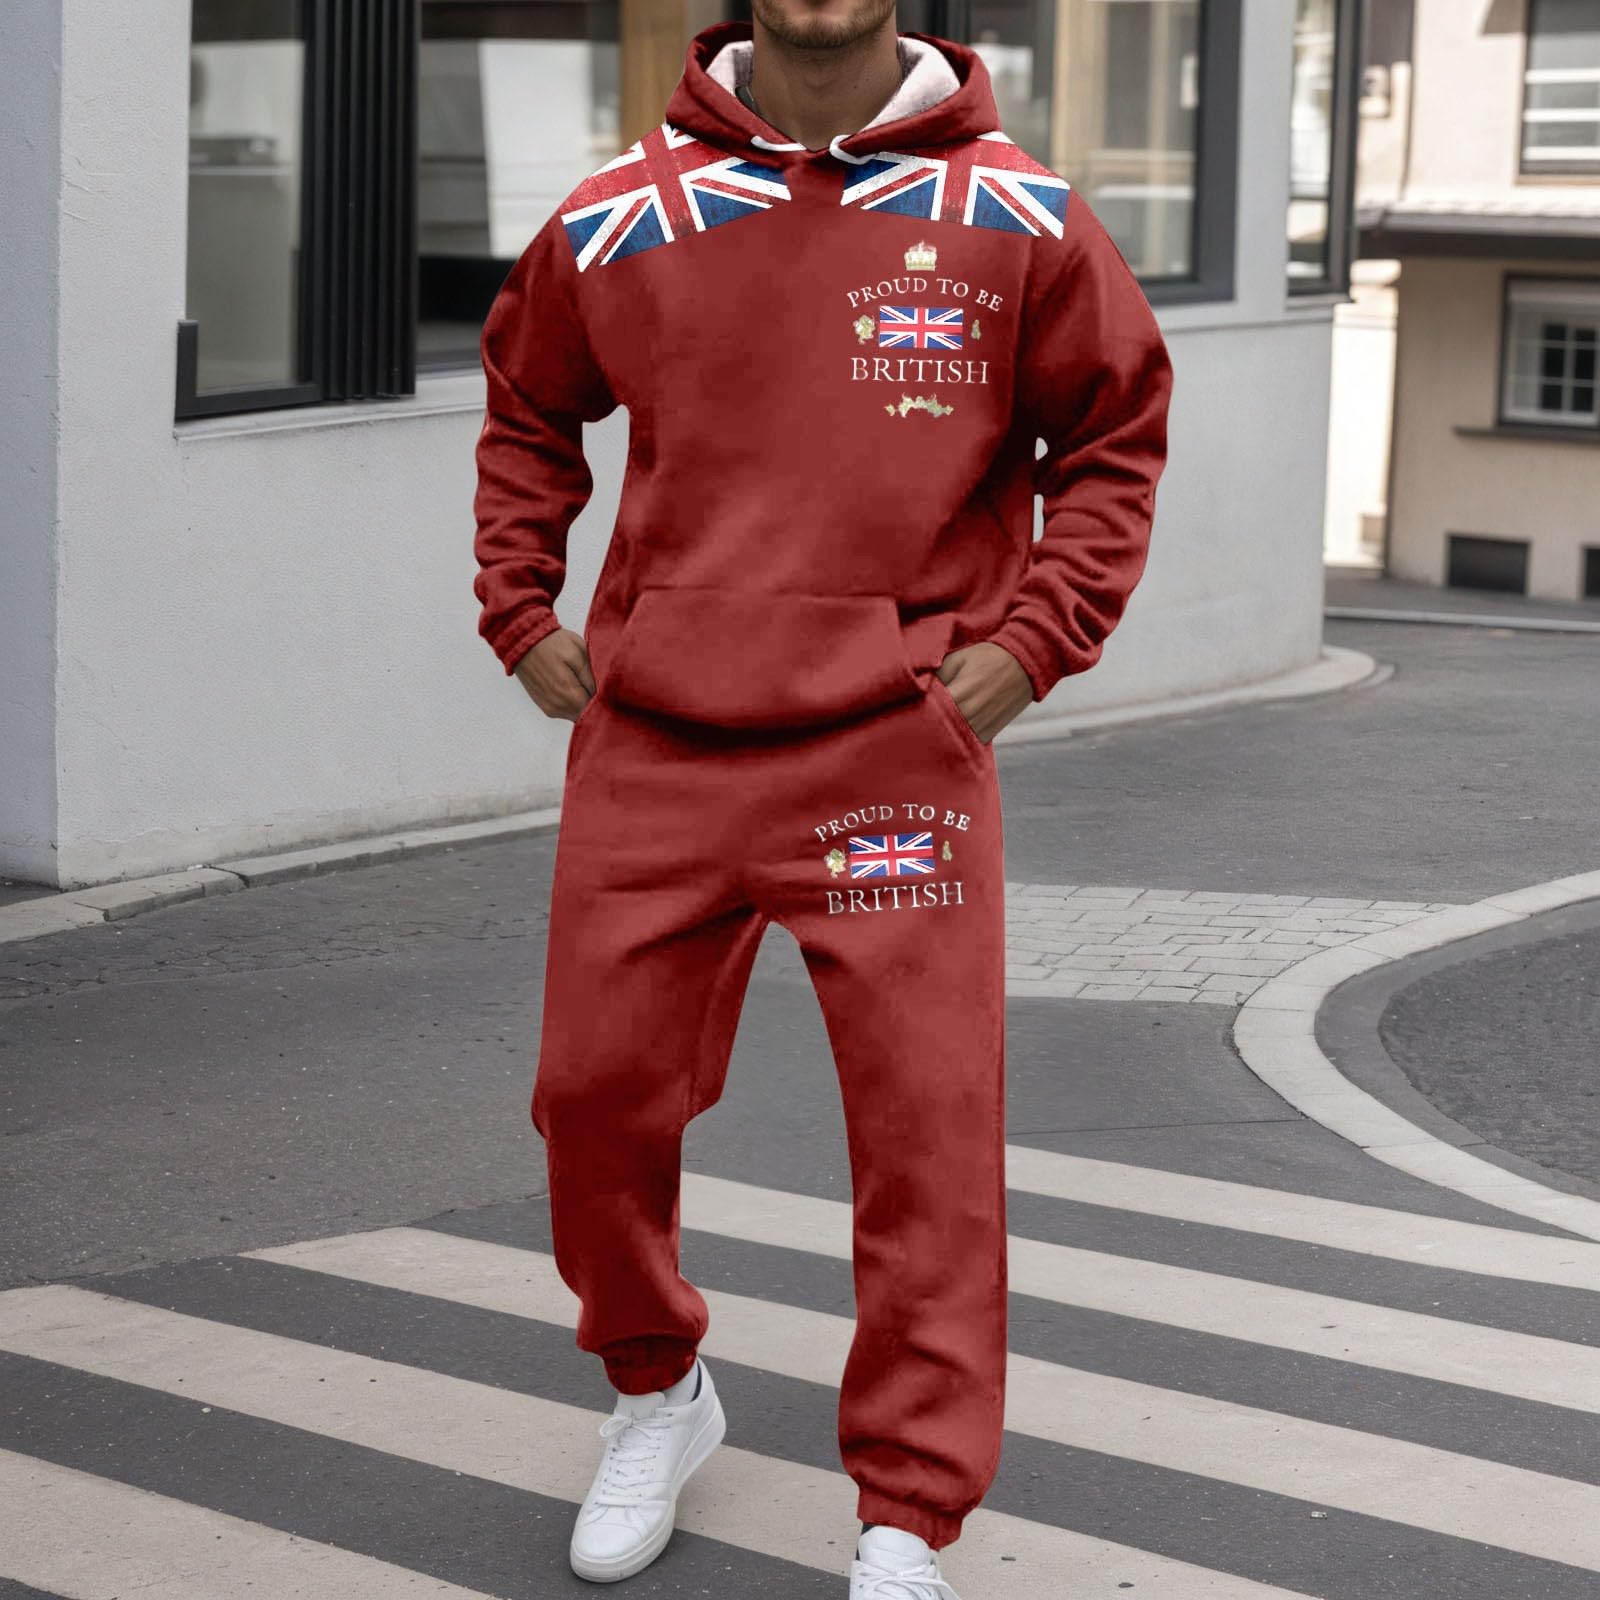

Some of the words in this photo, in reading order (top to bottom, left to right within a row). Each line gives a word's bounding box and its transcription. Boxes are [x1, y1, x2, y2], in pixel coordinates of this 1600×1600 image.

[847, 277, 927, 308] PROUD
[936, 278, 969, 297] TO
[975, 289, 1004, 312] BE
[851, 357, 990, 384] BRITISH
[814, 806, 894, 842] PROUD
[902, 804, 935, 821] TO
[943, 810, 971, 831] BE
[826, 881, 964, 915] BRITISH
